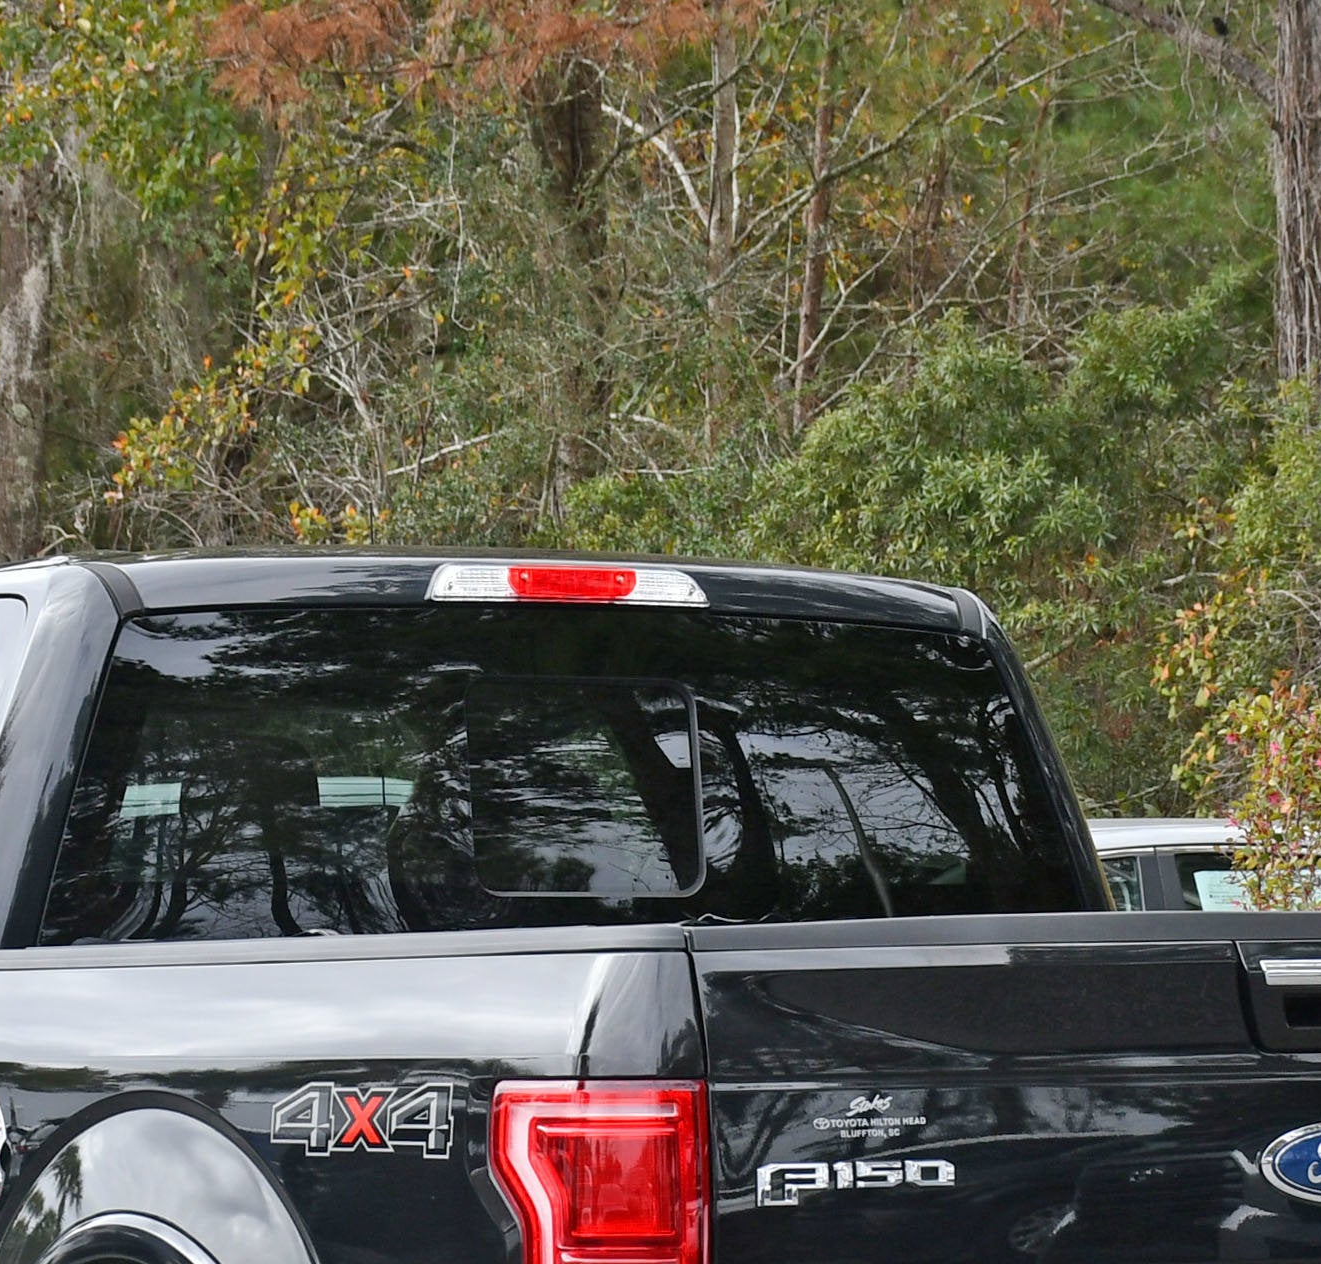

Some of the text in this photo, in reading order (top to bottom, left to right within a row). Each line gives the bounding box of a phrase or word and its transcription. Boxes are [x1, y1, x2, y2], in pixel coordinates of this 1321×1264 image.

[845, 1094, 893, 1117] Stokes
[830, 1116, 927, 1128] TOYOTA HILTON HEAD
[840, 1128, 901, 1138] BLUFFTON, SC
[756, 1160, 956, 1207] F150
